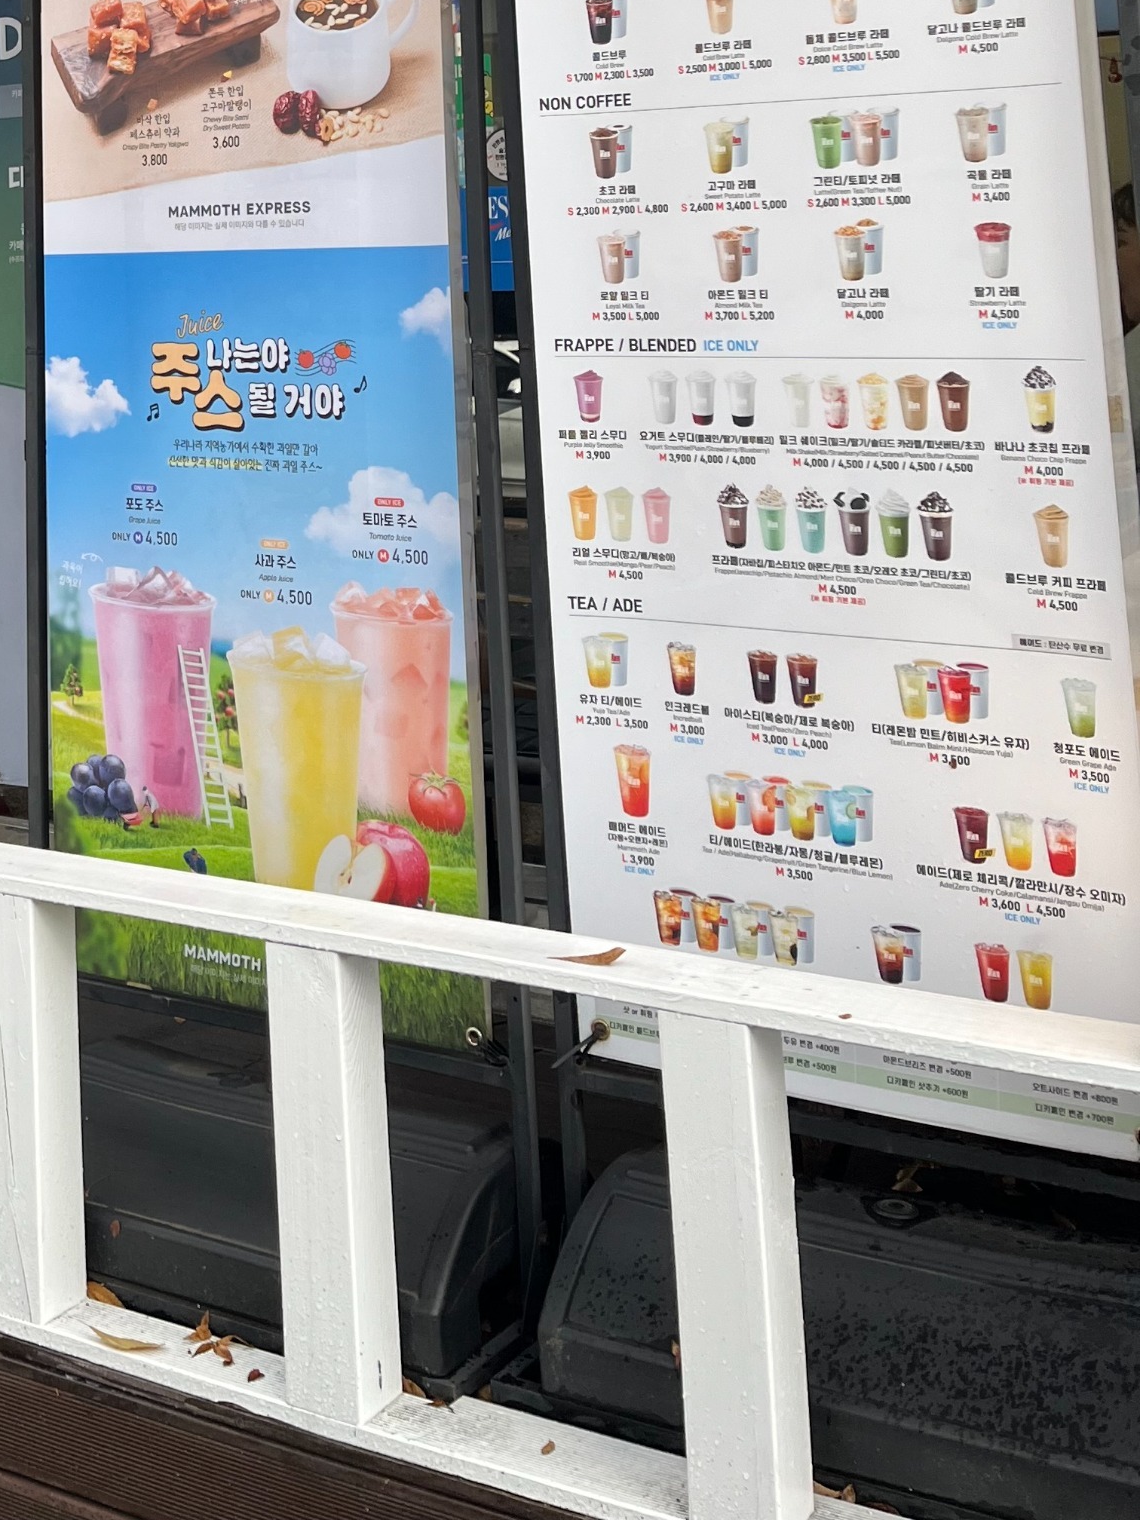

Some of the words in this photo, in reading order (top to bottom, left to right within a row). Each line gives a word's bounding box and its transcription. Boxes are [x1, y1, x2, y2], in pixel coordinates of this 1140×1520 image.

[927, 22, 959, 36] 달고나
[962, 19, 1002, 32] 콜드브루
[1006, 17, 1026, 29] 라떼
[971, 43, 998, 54] 4,500
[228, 85, 244, 97] 한입
[539, 97, 571, 111] NON
[576, 93, 631, 108] COFFEE
[137, 115, 152, 126] 바삭
[155, 113, 170, 124] 한입
[130, 128, 161, 140] 페스츄리
[164, 126, 180, 137] 약과
[213, 135, 240, 149] 3,600
[142, 154, 167, 166] 3,800
[708, 181, 735, 191] 고구마
[738, 180, 756, 190] 라떼
[984, 192, 1010, 203] 3,400
[168, 204, 240, 218] MAMMOTH
[246, 201, 311, 215] EXPRESS
[856, 310, 884, 321] 4,000
[176, 310, 224, 338] Juice
[555, 339, 614, 352] FRAPPE
[629, 339, 696, 352] BLENDED
[703, 340, 723, 351] ICE
[727, 340, 759, 352] ONLY
[206, 337, 290, 373] 나는야
[248, 383, 276, 418] 될
[283, 383, 345, 420] 거야
[174, 439, 203, 451] 우리나라
[205, 440, 249, 453] 지역농가에서
[251, 442, 274, 455] 수확한
[277, 443, 299, 456] 과일만
[303, 444, 318, 456] 갈아
[995, 442, 1025, 452] 바나나
[1028, 442, 1058, 453] 초코칩
[1061, 444, 1090, 455] 프라페
[586, 451, 610, 460] 3,900
[169, 456, 189, 467] 신선한
[191, 456, 206, 468] 맛과
[210, 457, 231, 469] 식감이
[233, 459, 262, 471] 살아있는
[265, 460, 279, 471] 진짜
[282, 460, 298, 472] 과일
[1036, 466, 1063, 476] 4,000
[126, 498, 143, 510] 포도
[146, 499, 163, 511] 주스
[363, 512, 394, 527] 토마토
[397, 514, 417, 528] 주스
[112, 532, 130, 541] ONLY
[145, 531, 177, 546] 4,500
[369, 532, 394, 541] Tomato
[396, 534, 412, 542] Juice
[255, 554, 274, 568] 사과
[277, 556, 296, 569] 주스
[352, 550, 374, 560] ONLY
[392, 549, 428, 565] 4,500
[240, 590, 260, 599] ONLY
[277, 589, 312, 605] 4,500
[568, 596, 598, 611] TEA
[613, 599, 643, 613] ADE
[1054, 742, 1086, 758] 청포도
[1089, 748, 1121, 761] 에이드
[1081, 770, 1110, 783] 3,500
[630, 855, 655, 867] 3,900
[991, 898, 1020, 911] 3,600
[1036, 905, 1065, 918] 4,500
[184, 943, 261, 971] MAMMOTH
[883, 1054, 927, 1071] 아몬드브리즈
[928, 1064, 943, 1075] 변경
[946, 1066, 972, 1080] +500원
